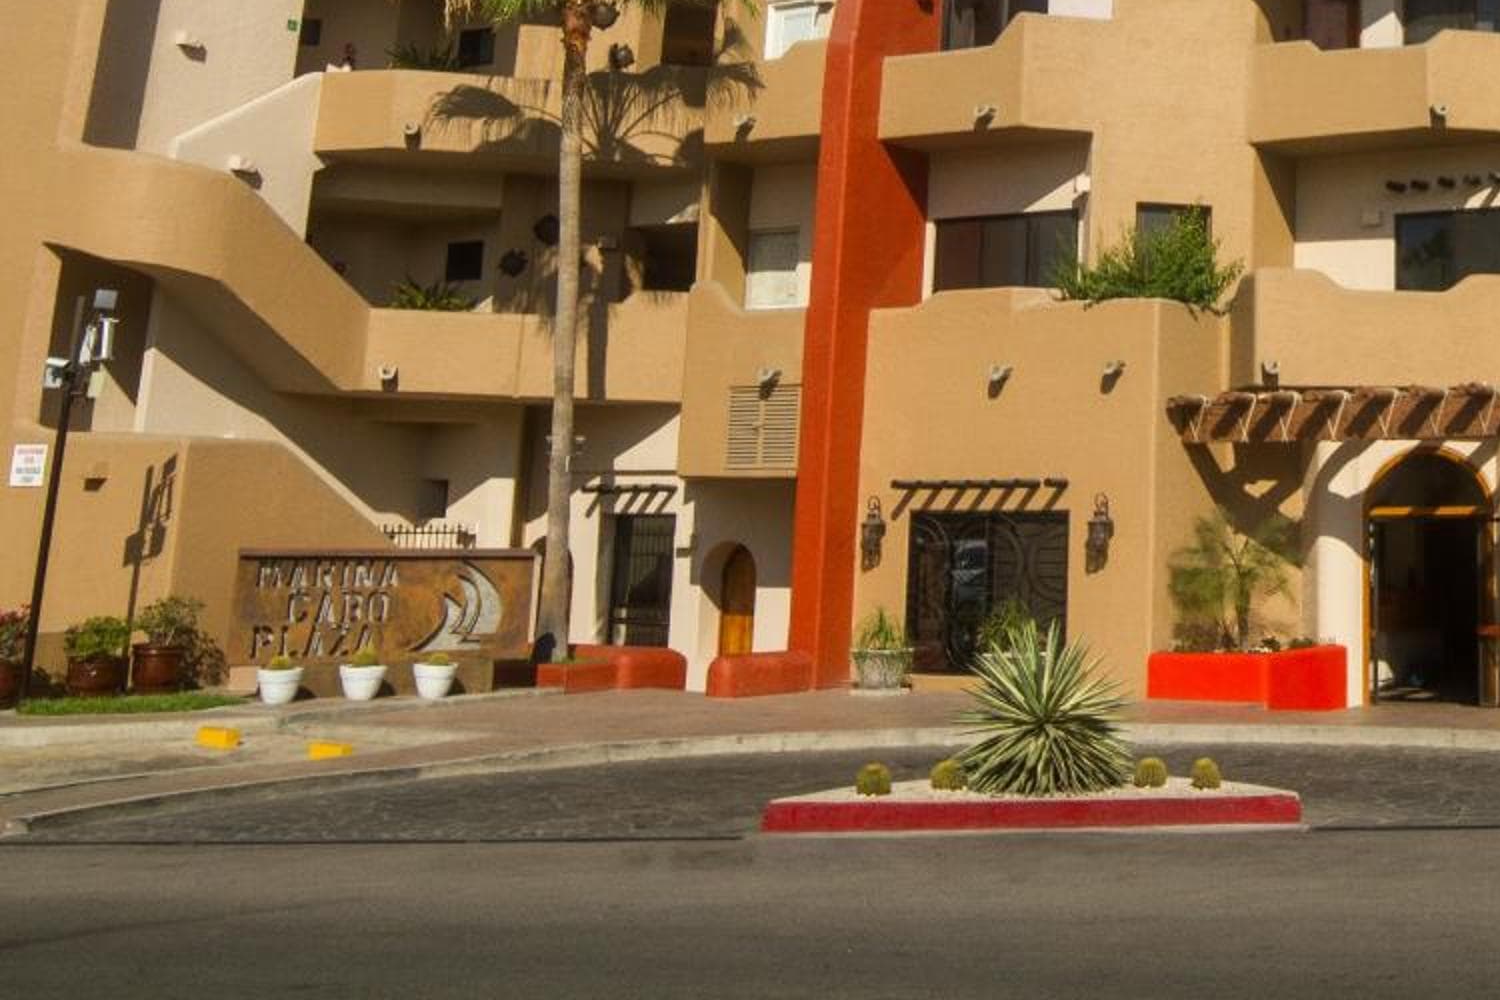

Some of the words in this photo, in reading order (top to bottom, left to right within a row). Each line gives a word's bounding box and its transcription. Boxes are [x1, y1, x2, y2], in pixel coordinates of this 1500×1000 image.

[256, 561, 399, 588] MARINA
[288, 590, 391, 626] CABO
[250, 625, 375, 659] PLAZA
